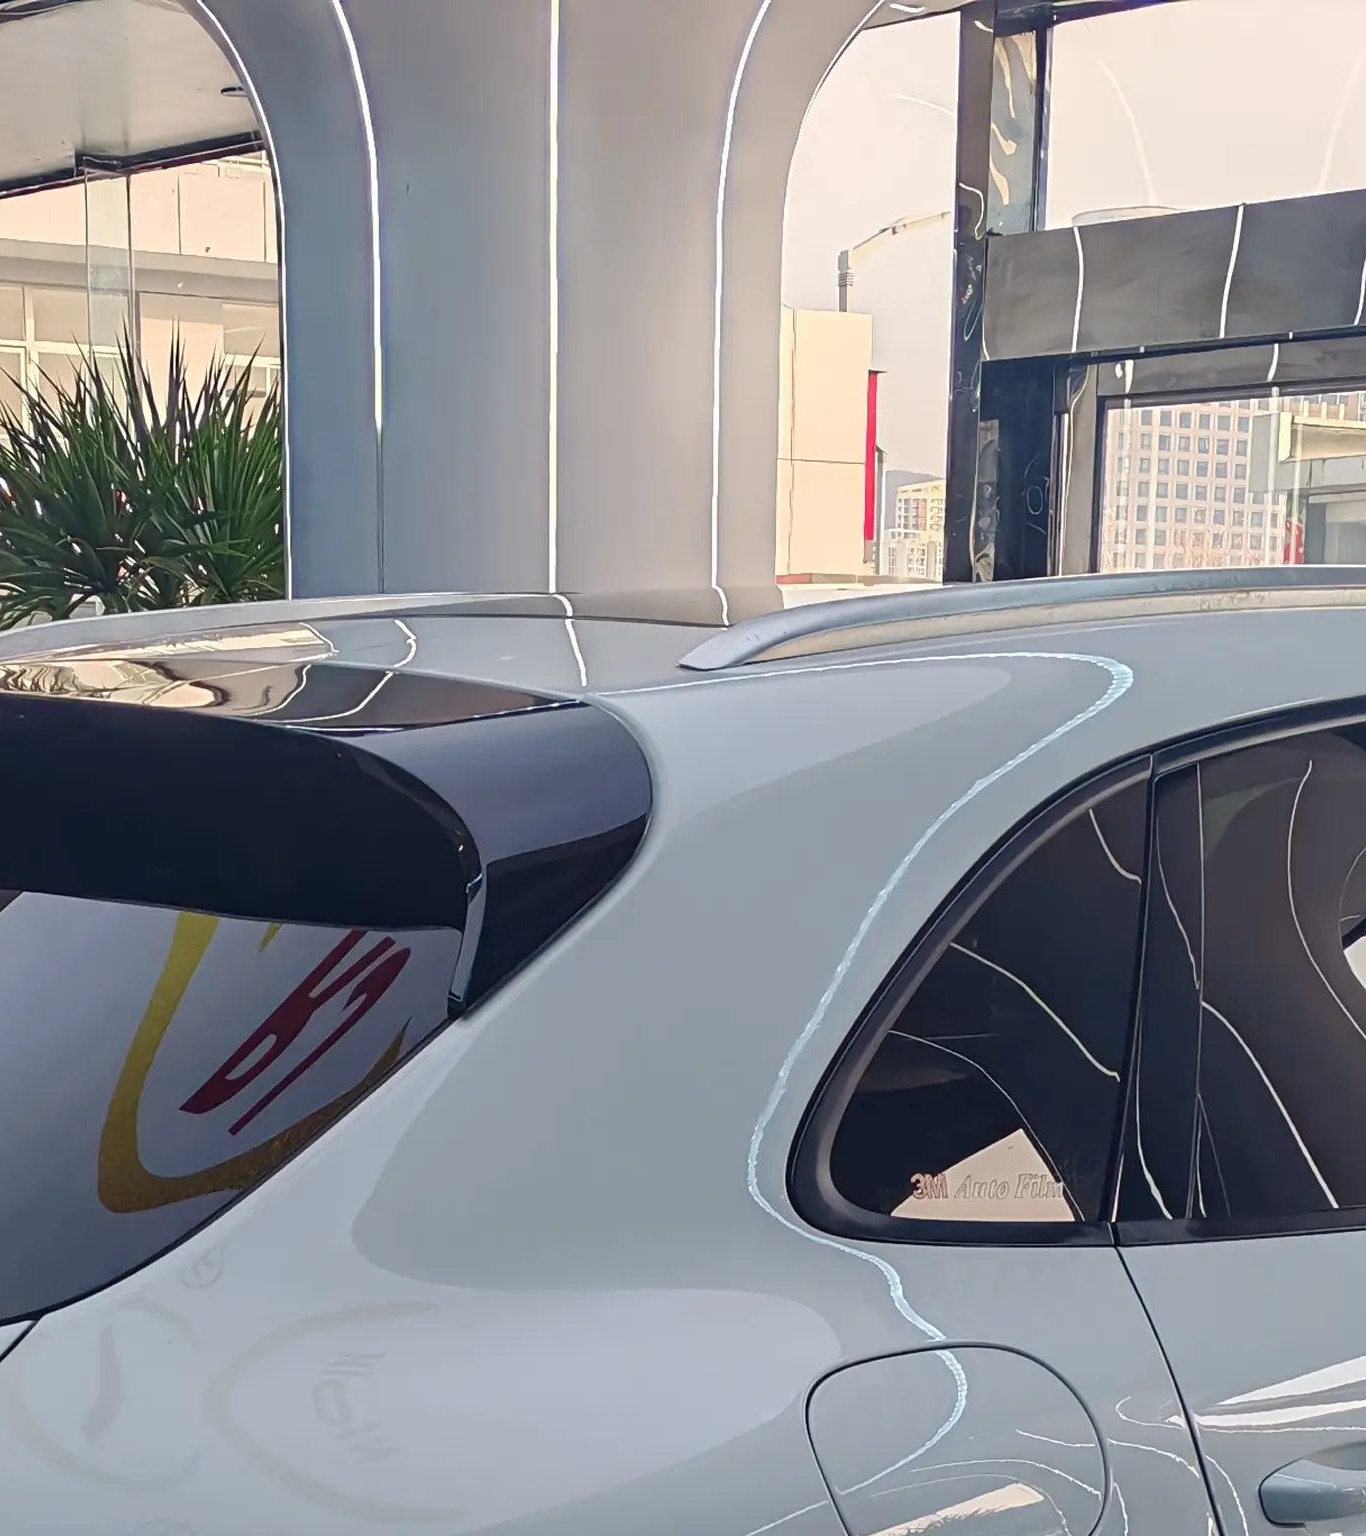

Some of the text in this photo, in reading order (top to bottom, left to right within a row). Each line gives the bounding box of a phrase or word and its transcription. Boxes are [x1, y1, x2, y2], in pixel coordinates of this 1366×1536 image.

[909, 1172, 1063, 1200] 3M Auto Film
